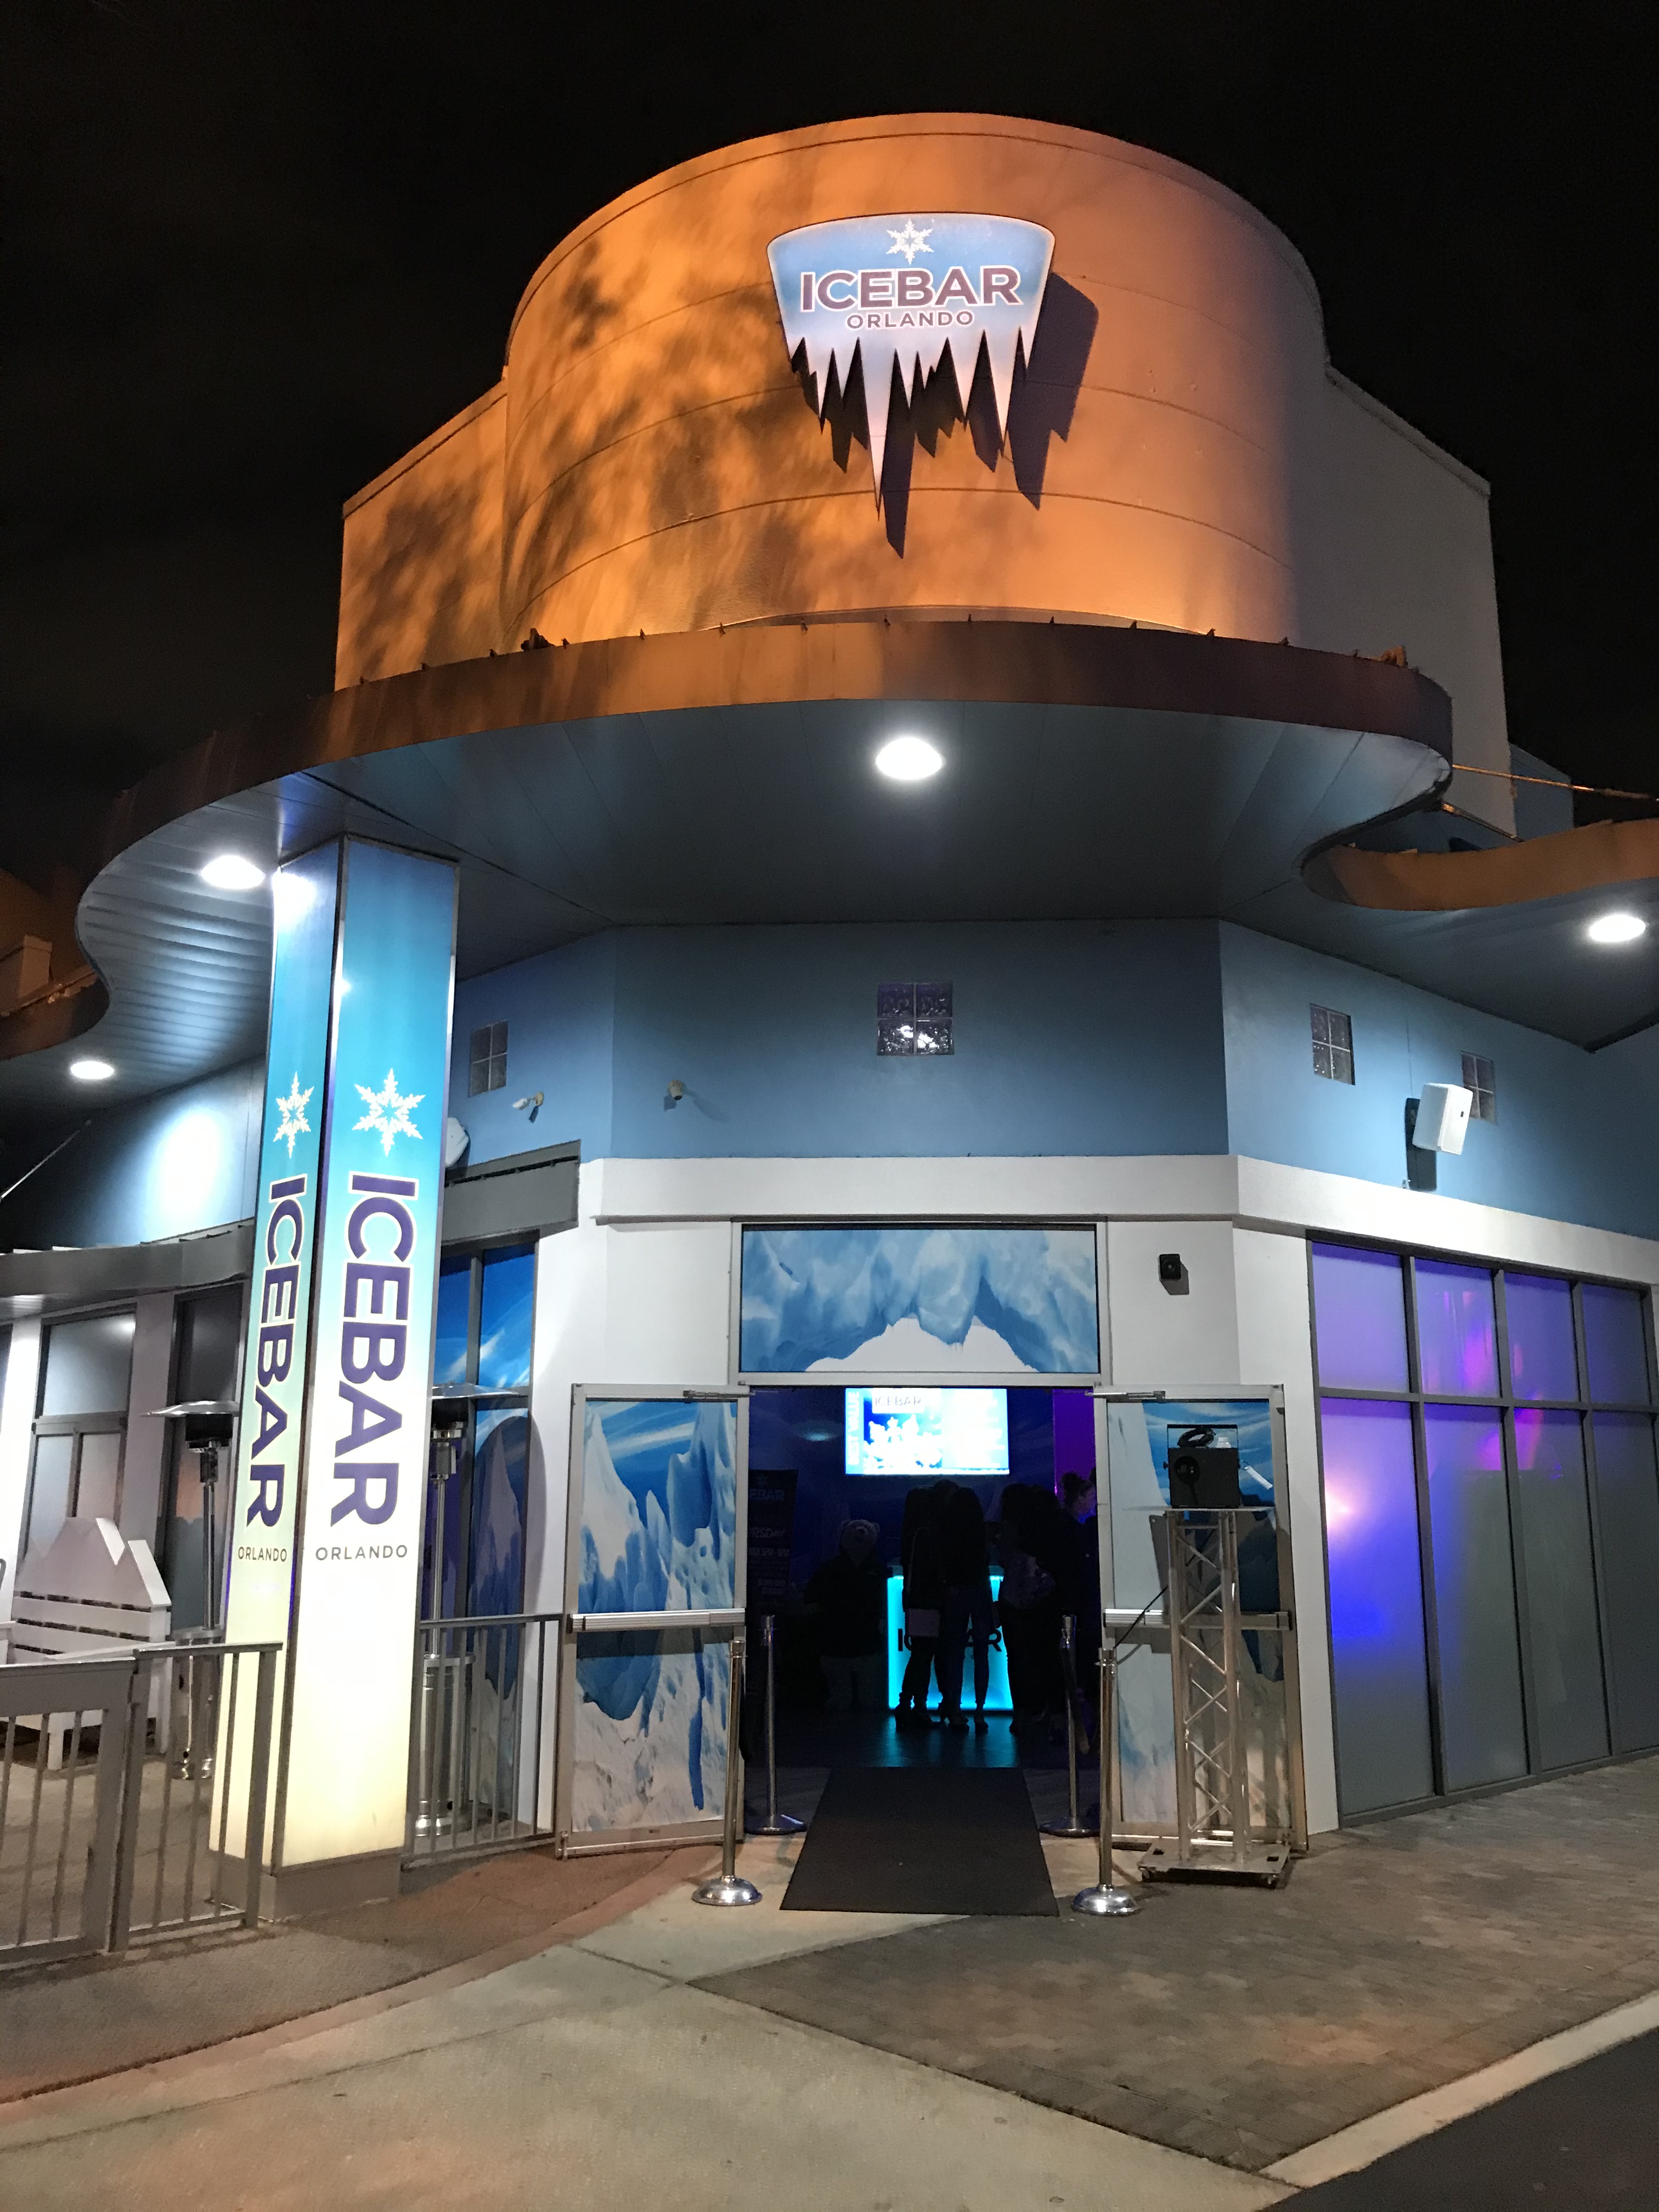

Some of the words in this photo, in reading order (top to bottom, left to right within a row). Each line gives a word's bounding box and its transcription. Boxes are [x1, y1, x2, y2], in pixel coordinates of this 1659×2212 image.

[801, 266, 1023, 312] ICEBAR
[847, 311, 973, 329] ORLANDO
[247, 1173, 307, 1527] ICEBAR
[330, 1171, 420, 1527] ICEBAR
[238, 1546, 287, 1562] ORLANDO
[315, 1544, 408, 1561] ORLANDO
